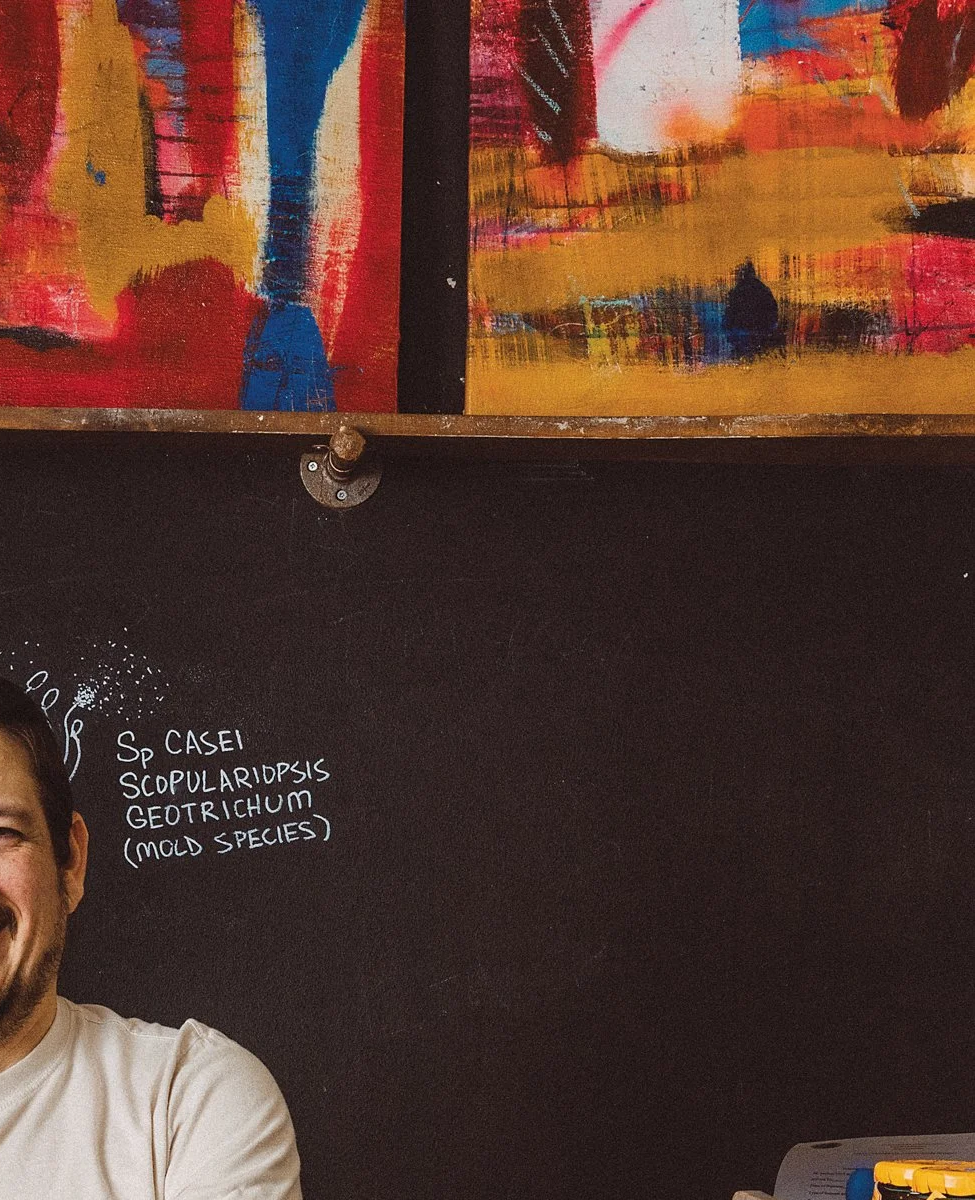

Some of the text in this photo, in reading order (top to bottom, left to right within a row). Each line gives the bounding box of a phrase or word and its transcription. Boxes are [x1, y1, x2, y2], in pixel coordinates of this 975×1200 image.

[165, 729, 243, 755] CASEI
[119, 758, 330, 799] SCOPULARIOPSIS
[214, 814, 331, 854] SPECIES)
